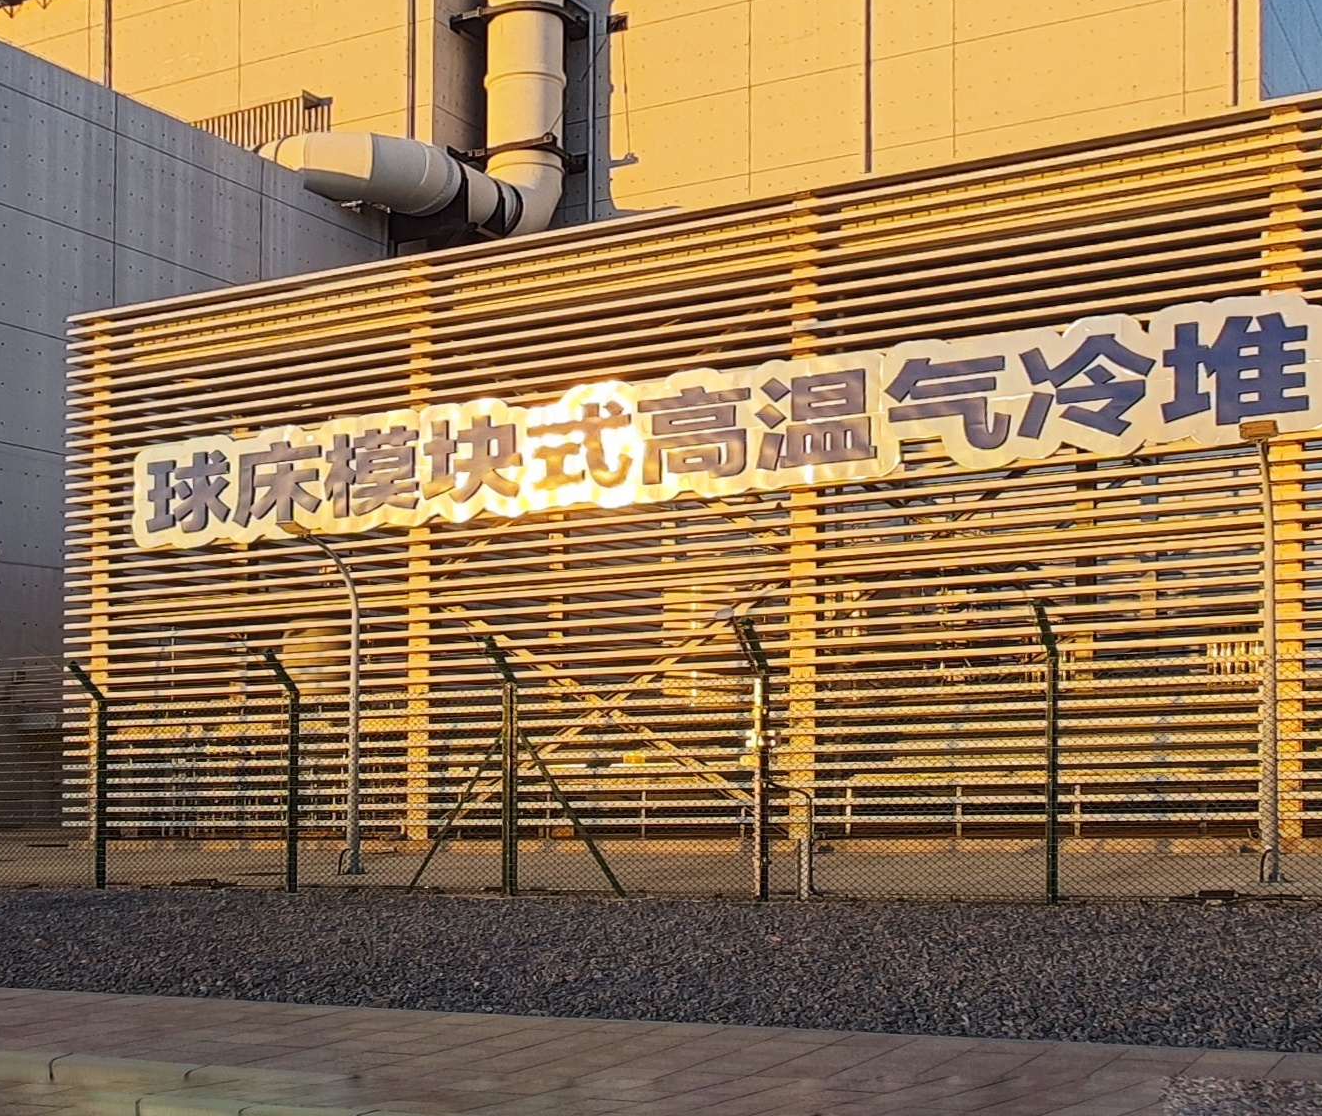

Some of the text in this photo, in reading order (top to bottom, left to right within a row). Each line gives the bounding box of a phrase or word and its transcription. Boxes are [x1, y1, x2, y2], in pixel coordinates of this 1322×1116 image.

[145, 312, 1309, 534] 球床模块式高温气冷堆
